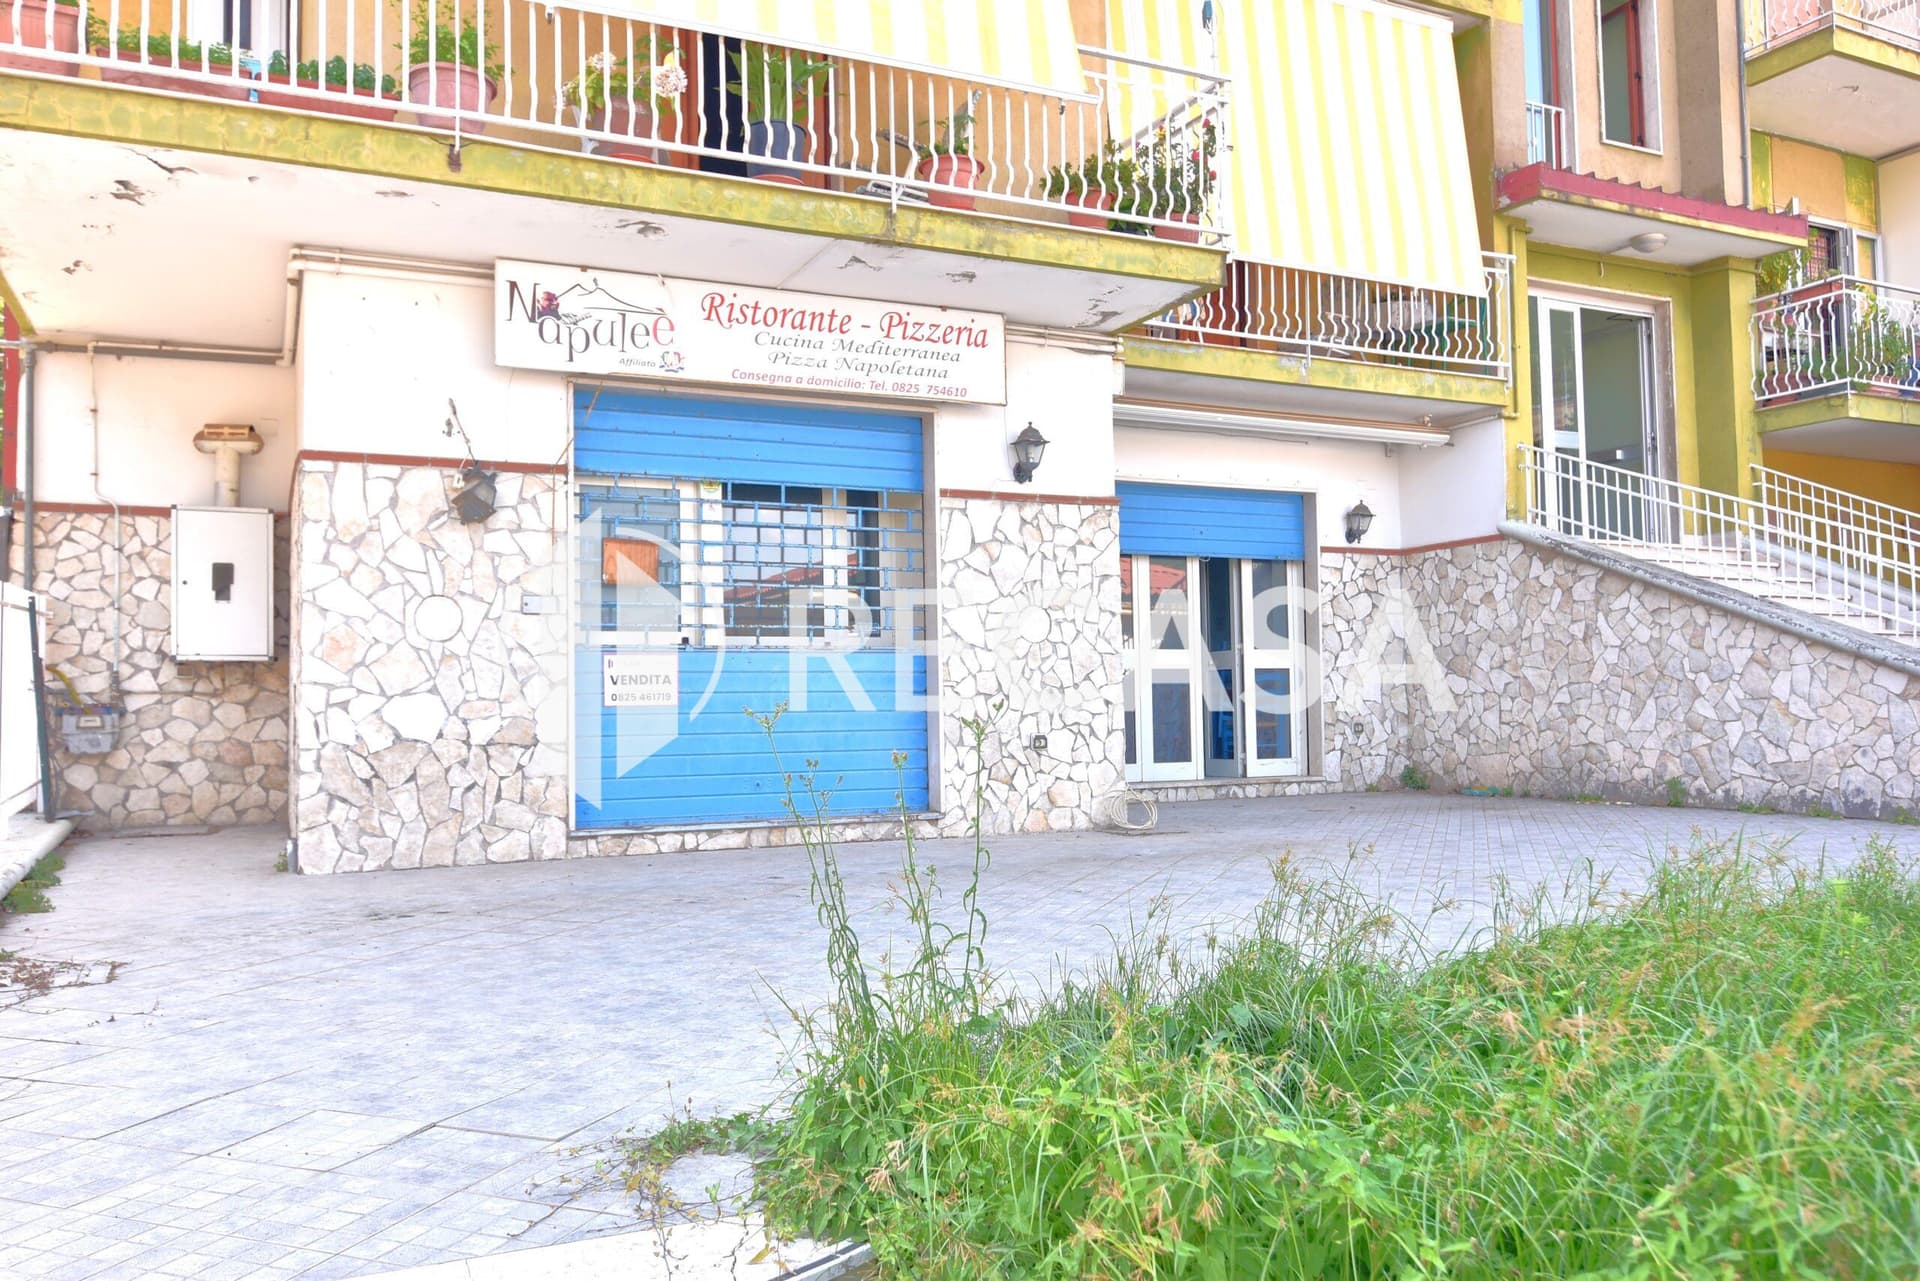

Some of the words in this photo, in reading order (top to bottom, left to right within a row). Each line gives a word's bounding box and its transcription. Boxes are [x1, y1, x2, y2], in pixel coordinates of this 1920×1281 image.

[701, 292, 852, 335] Ristorante
[879, 311, 989, 349] Pizzeria
[754, 331, 825, 350] Cucina
[832, 337, 961, 363] Mediterranea
[618, 356, 657, 369] Affiliato
[768, 351, 828, 369] Pizza
[834, 357, 949, 379] Napoletana
[731, 368, 793, 385] Consegna
[796, 375, 804, 385] a
[806, 375, 866, 390] domicilio:
[869, 379, 889, 392] Tel.
[891, 381, 920, 394] 0825
[926, 384, 968, 398] 754610
[610, 675, 672, 686] VENDITA
[611, 693, 637, 702] 0825
[639, 693, 672, 702] 461719
